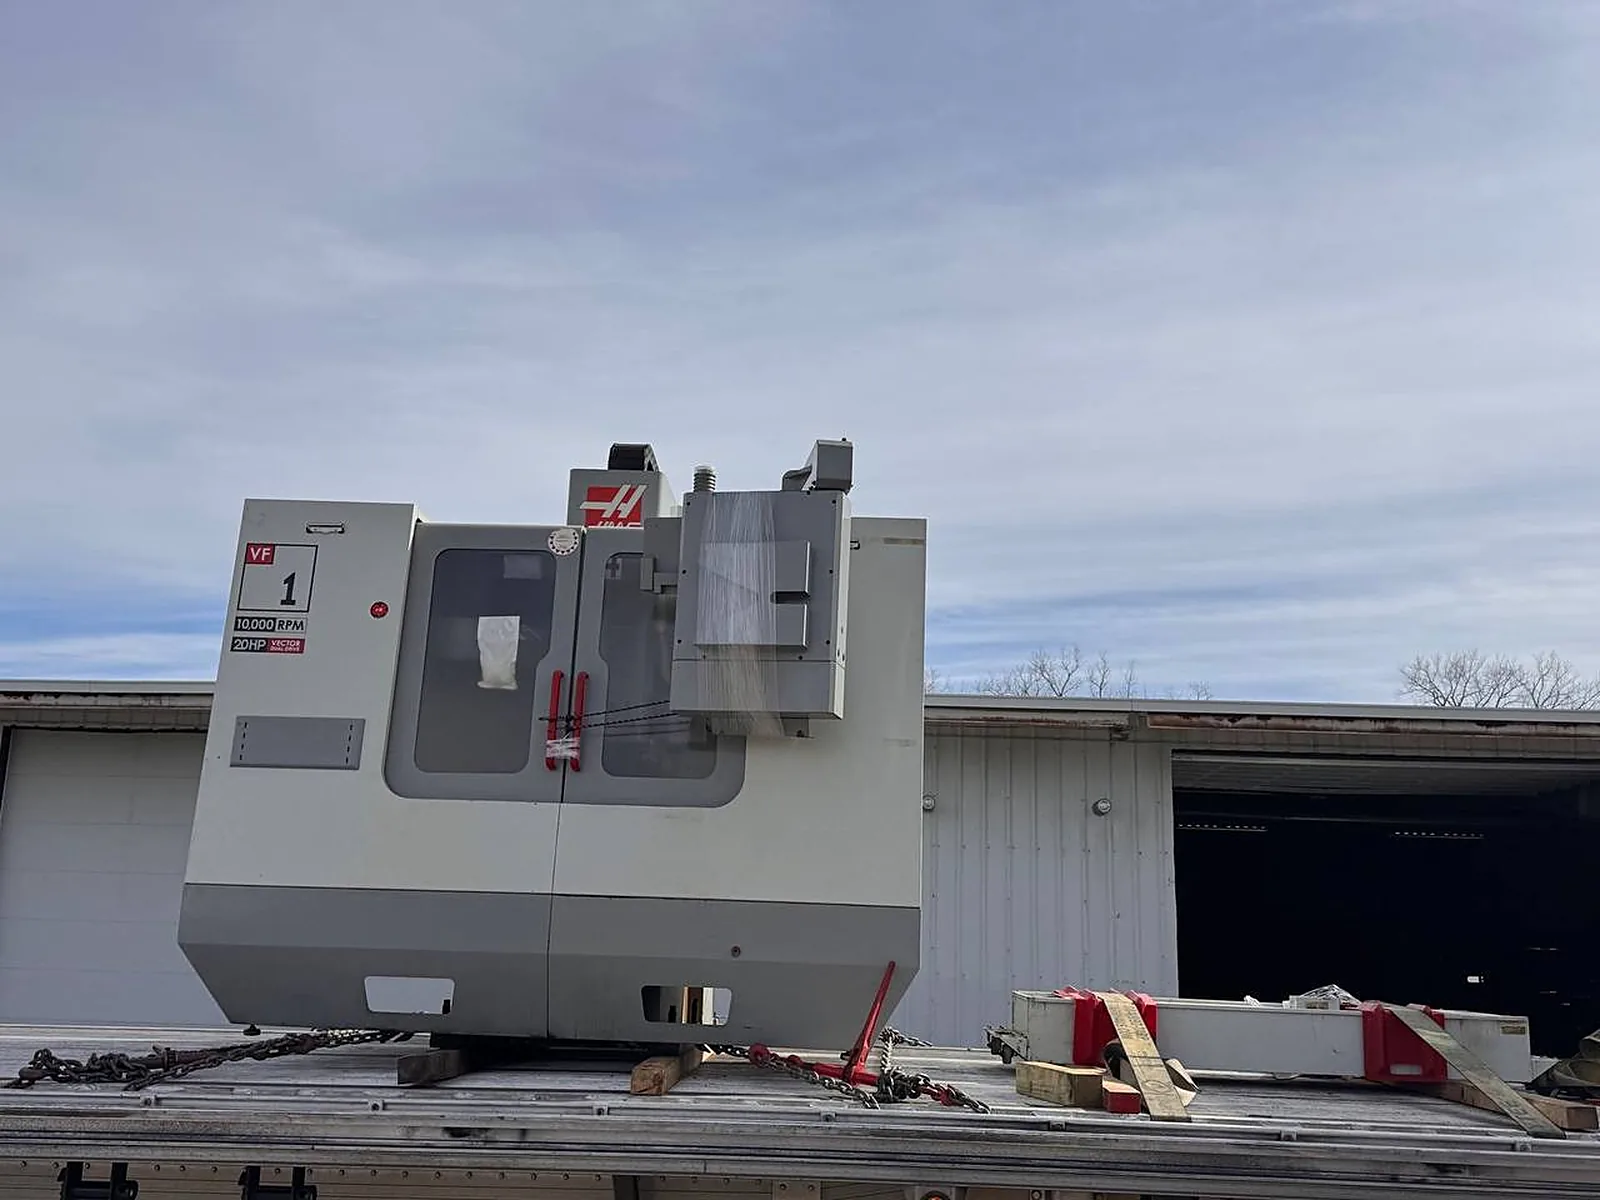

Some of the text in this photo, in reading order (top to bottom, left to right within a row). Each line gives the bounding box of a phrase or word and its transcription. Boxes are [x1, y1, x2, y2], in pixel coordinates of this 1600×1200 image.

[250, 547, 271, 560] VF
[280, 572, 296, 605] 1
[237, 618, 304, 631] 10,000 RPM
[233, 639, 266, 651] 20HP
